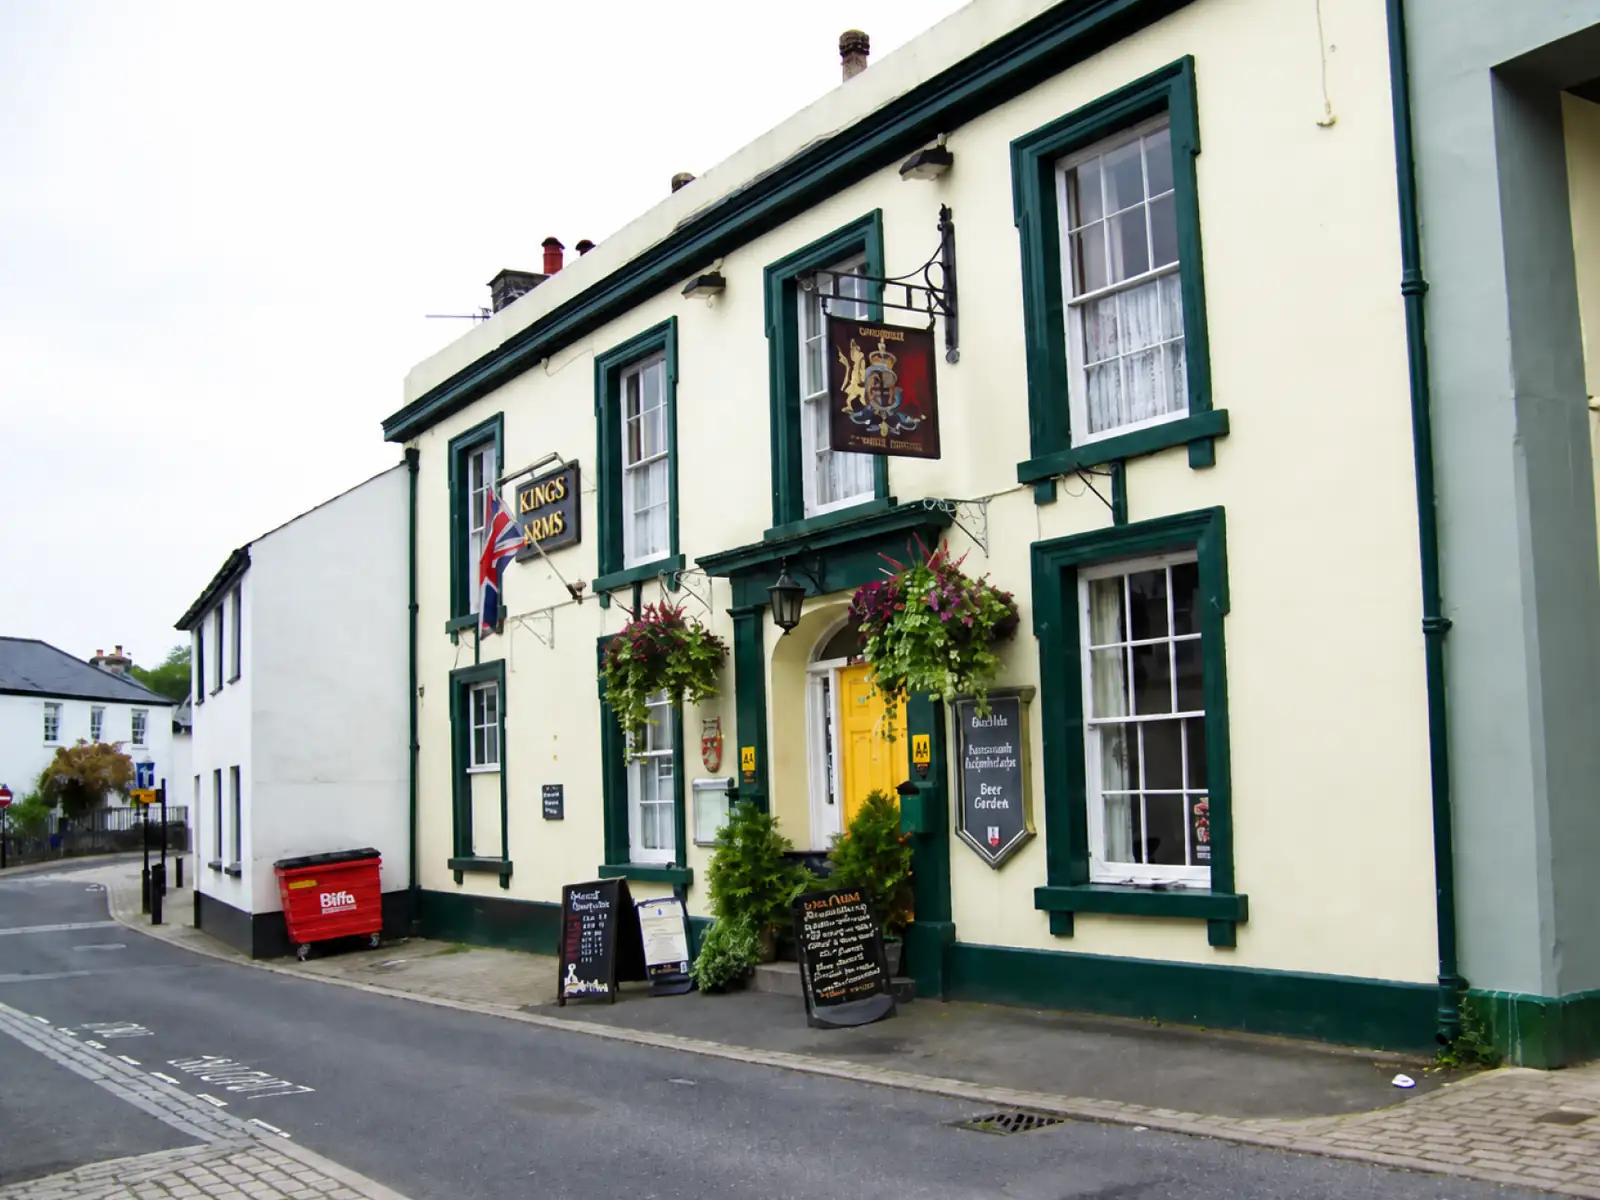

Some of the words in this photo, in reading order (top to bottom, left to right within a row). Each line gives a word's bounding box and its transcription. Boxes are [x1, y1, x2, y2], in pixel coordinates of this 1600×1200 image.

[519, 476, 566, 514] KINGS
[523, 511, 564, 542] ARMS
[915, 741, 929, 758] AA
[980, 783, 1003, 795] Beer
[974, 797, 1010, 809] Garden
[320, 890, 356, 908] Biffa
